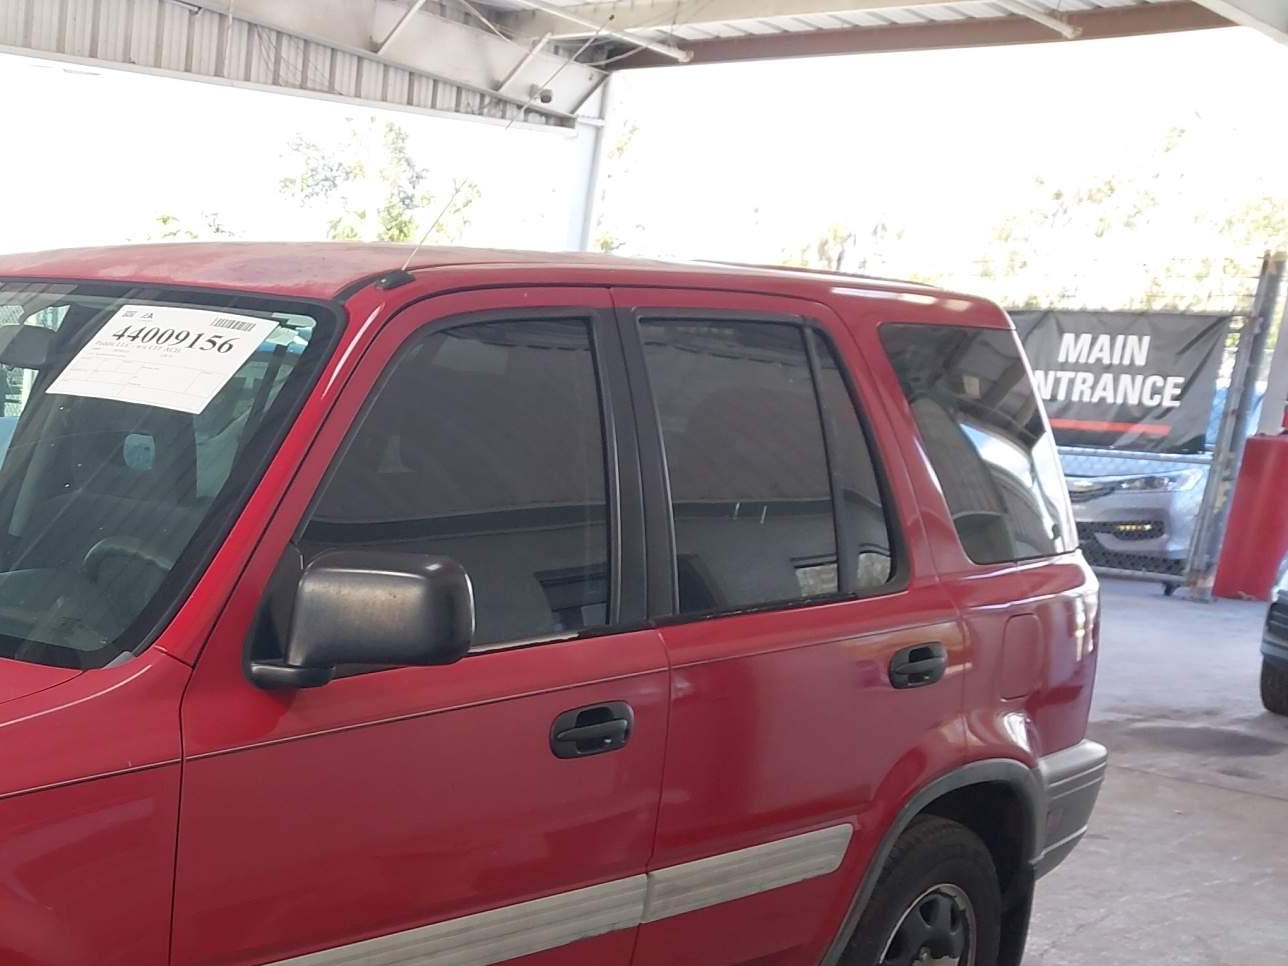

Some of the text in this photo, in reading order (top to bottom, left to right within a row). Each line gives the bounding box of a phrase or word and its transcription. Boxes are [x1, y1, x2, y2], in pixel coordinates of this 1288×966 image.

[112, 325, 240, 354] 44009156
[1058, 333, 1151, 366] MAIN
[1034, 370, 1185, 408] NTRANCE
